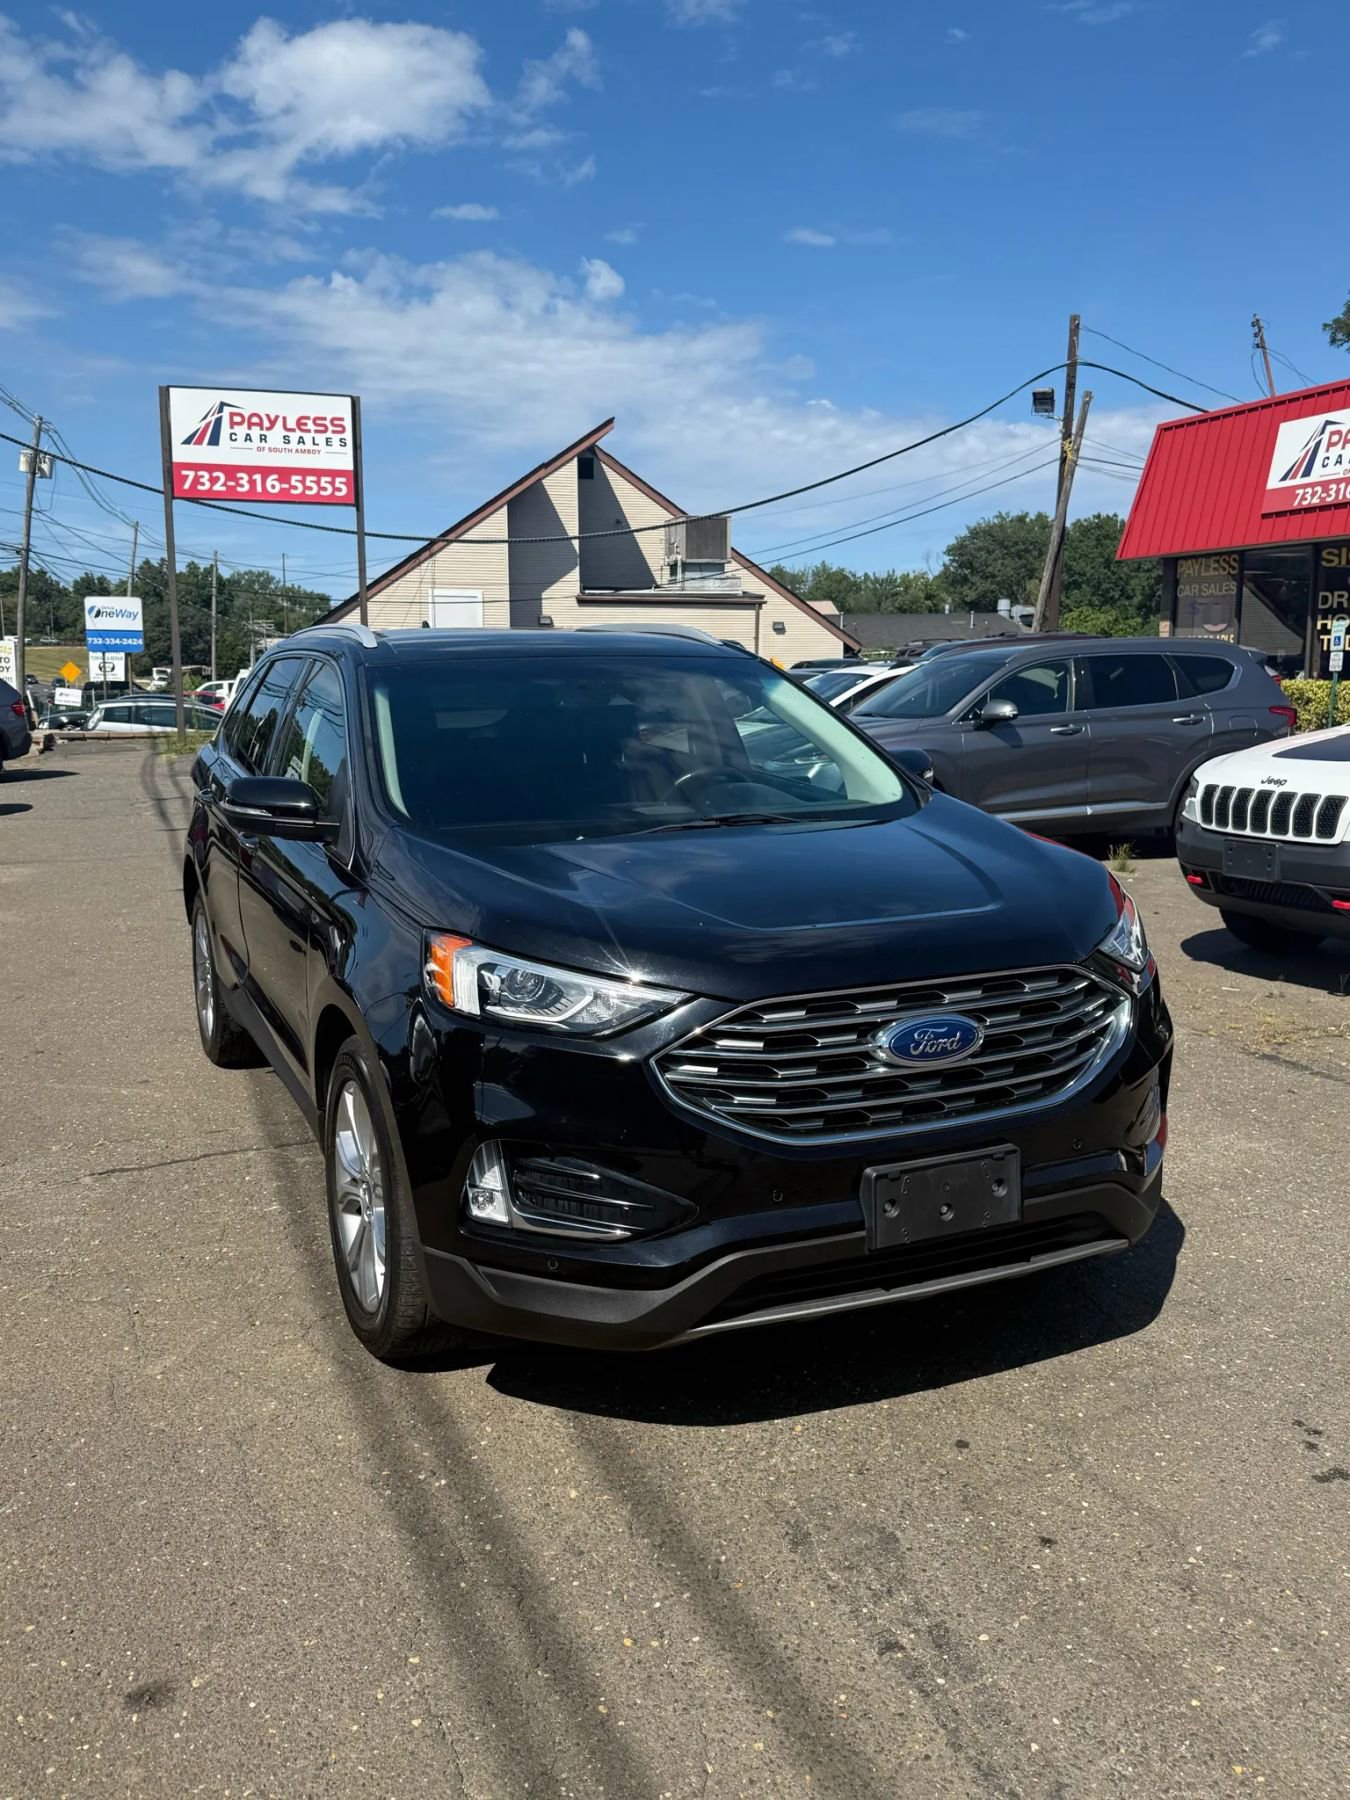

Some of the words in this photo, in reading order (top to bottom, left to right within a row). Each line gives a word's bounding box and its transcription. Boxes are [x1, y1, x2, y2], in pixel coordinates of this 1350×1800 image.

[229, 411, 347, 435] PAYLESS
[229, 432, 268, 444] CAR
[283, 434, 347, 448] SALES
[1325, 428, 1350, 453] PA
[268, 447, 293, 455] SOUTH
[295, 448, 322, 456] AMBOY
[1321, 453, 1350, 469] CA
[180, 469, 348, 497] 732-316-5555
[1176, 554, 1239, 579] PAYLESS
[1321, 546, 1350, 568] SI
[1176, 583, 1199, 598] CAR
[1201, 580, 1237, 597] SALES
[88, 637, 143, 645] 732-334-2424
[1260, 775, 1288, 787] Jeep
[910, 1026, 961, 1055] Ford
